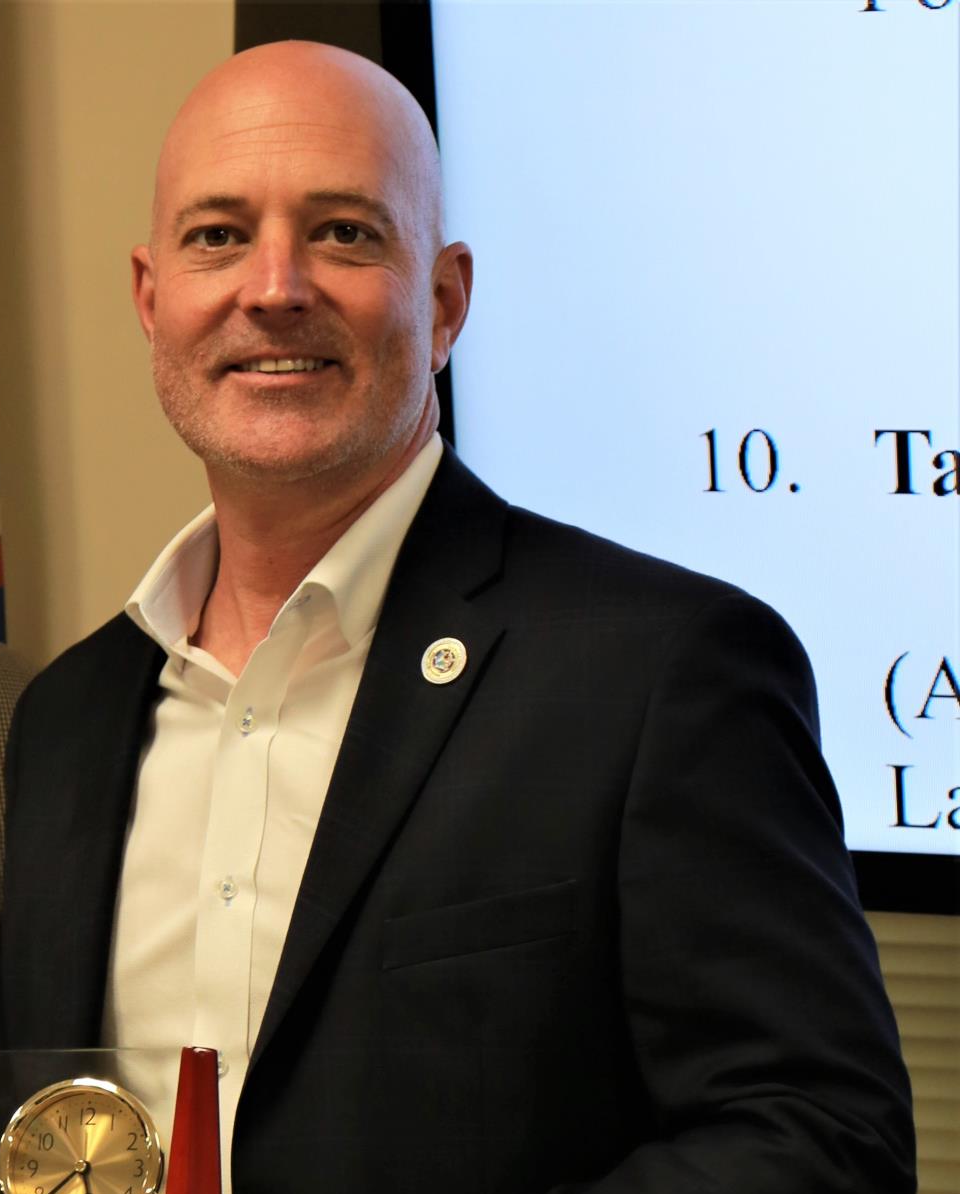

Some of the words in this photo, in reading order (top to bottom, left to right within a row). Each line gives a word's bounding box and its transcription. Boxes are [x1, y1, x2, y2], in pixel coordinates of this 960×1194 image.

[699, 428, 801, 494] 10.
[873, 428, 960, 498] Ta
[58, 1115, 69, 1133] 11
[79, 1107, 97, 1126] 12
[37, 1132, 55, 1152] 10
[126, 1132, 139, 1151] 2
[26, 1159, 39, 1179] 9
[133, 1159, 145, 1178] 3
